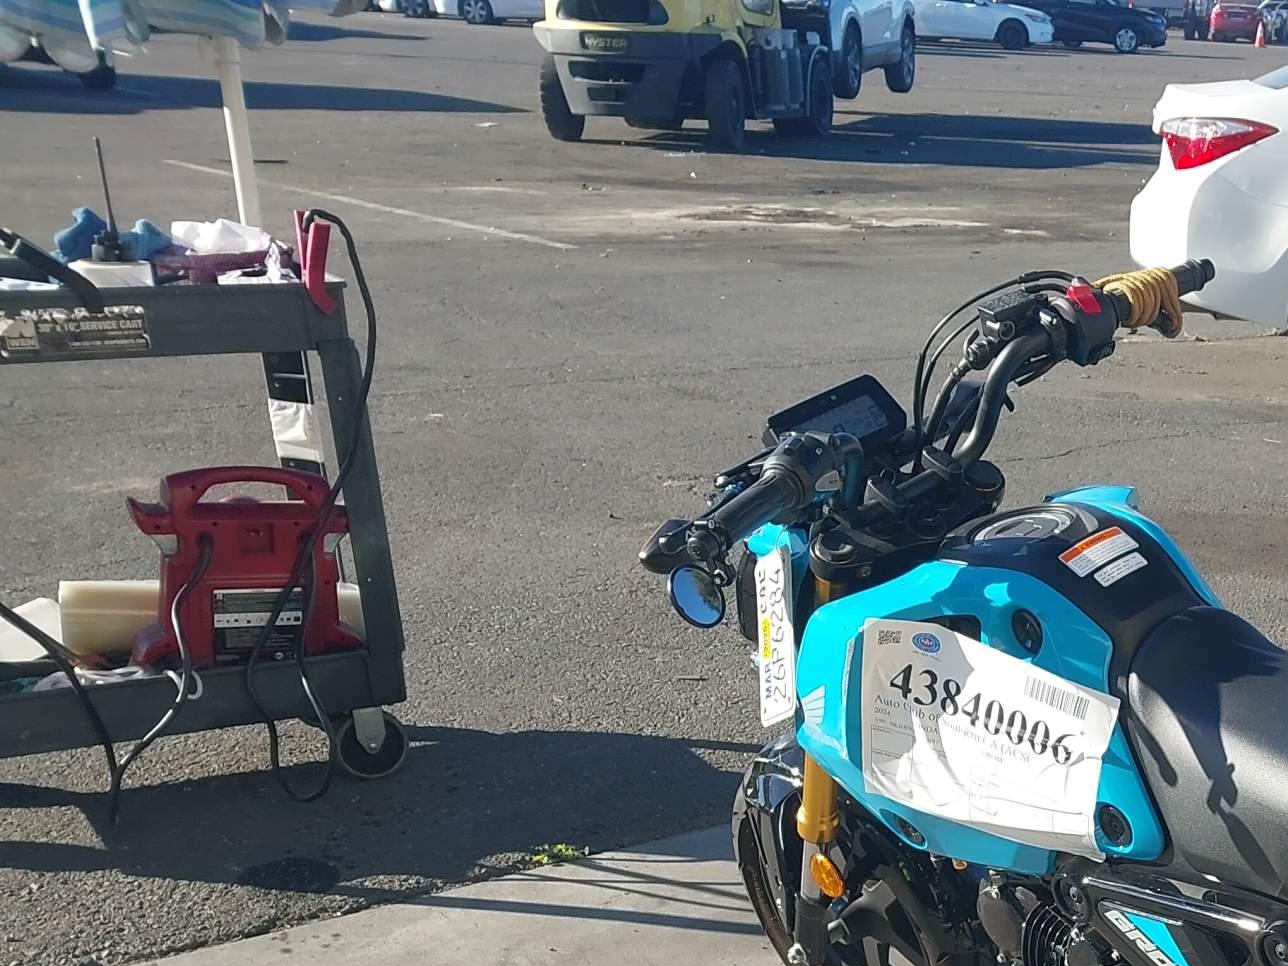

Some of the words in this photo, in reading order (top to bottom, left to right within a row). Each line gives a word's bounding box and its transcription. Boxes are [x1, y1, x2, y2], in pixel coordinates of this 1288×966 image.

[584, 35, 628, 49] HYSTER
[79, 320, 119, 331] SERVICE
[119, 319, 143, 330] CART
[874, 694, 900, 710] Auto
[874, 706, 891, 717] 2024
[889, 662, 1076, 766] 43840006
